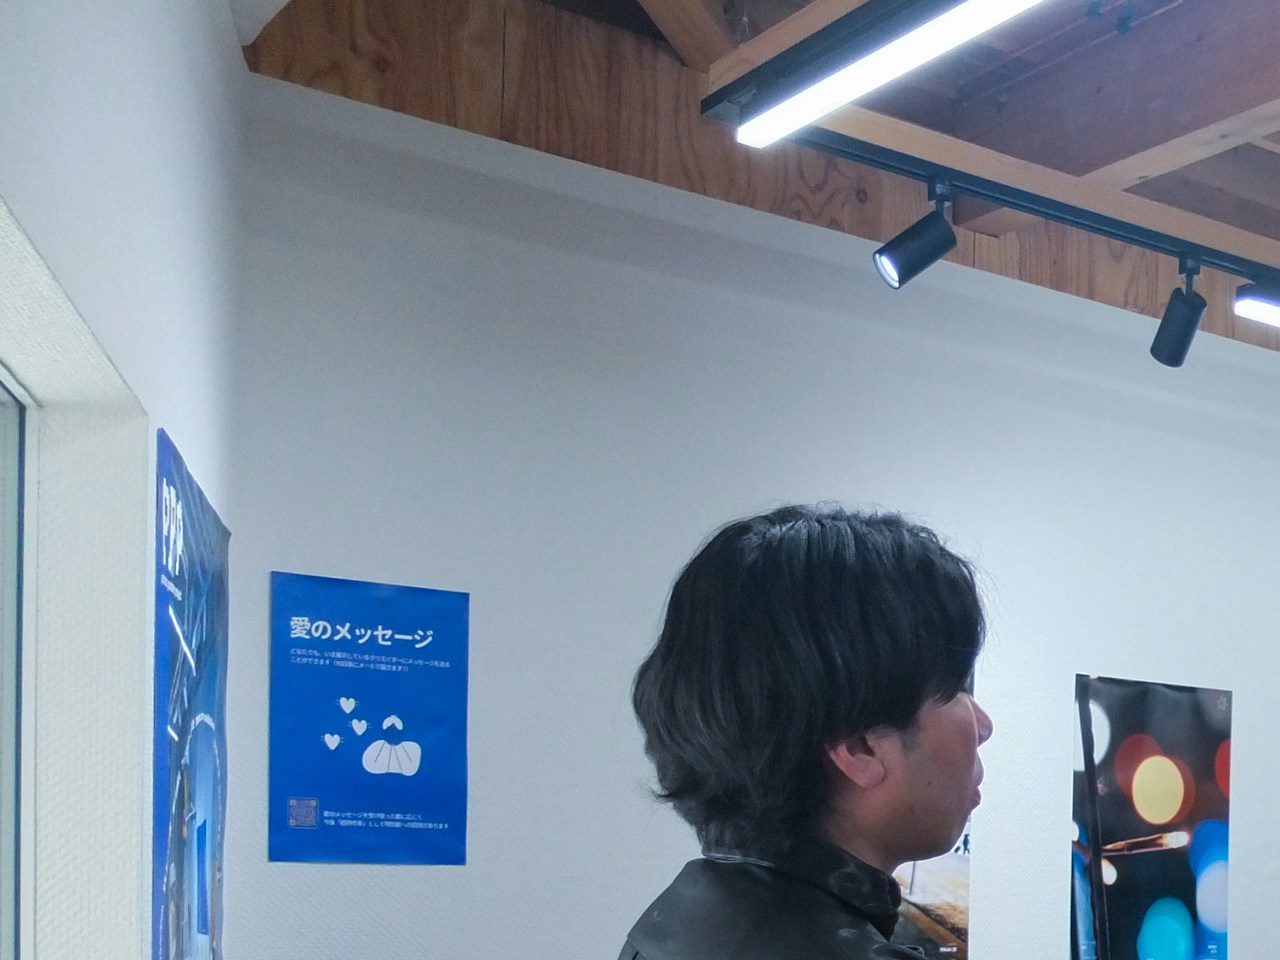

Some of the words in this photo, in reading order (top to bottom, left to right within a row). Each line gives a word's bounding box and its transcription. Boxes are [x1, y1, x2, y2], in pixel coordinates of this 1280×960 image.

[290, 616, 434, 649] 愛のメッセージ
